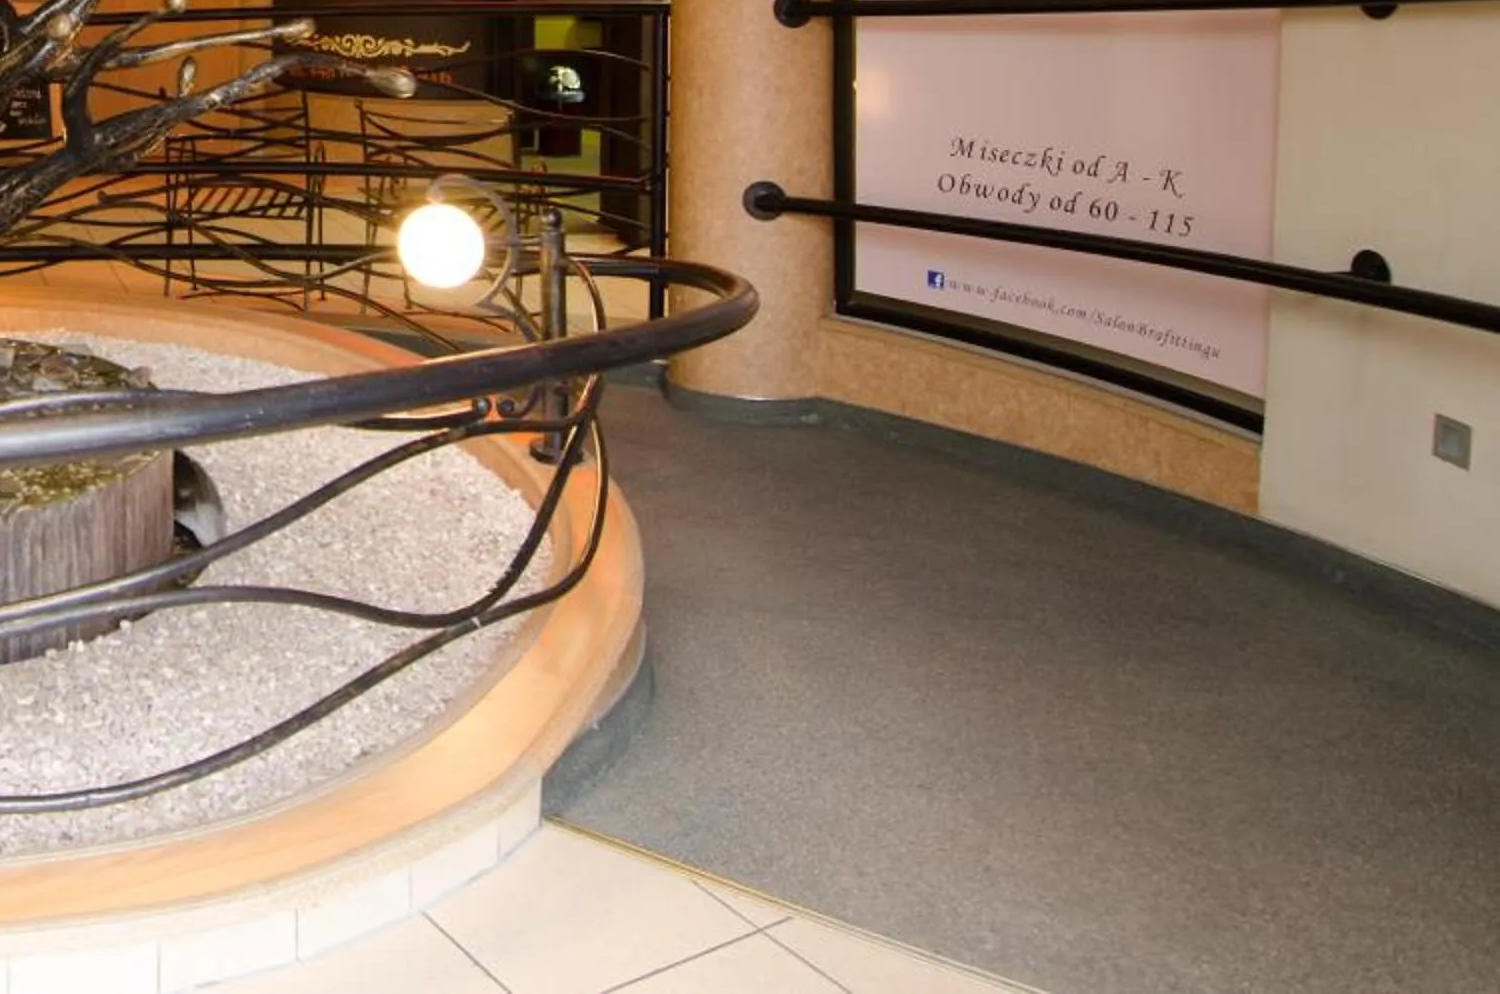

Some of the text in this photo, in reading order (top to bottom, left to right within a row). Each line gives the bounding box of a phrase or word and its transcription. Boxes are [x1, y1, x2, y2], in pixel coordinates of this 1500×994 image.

[950, 137, 1065, 177] Miseczki
[1072, 155, 1106, 178] od
[1106, 160, 1129, 183] A
[1159, 169, 1186, 199] K
[937, 173, 1041, 214] Obwody
[1049, 191, 1083, 214] od
[1088, 196, 1120, 221] 60
[1148, 209, 1195, 237] 115
